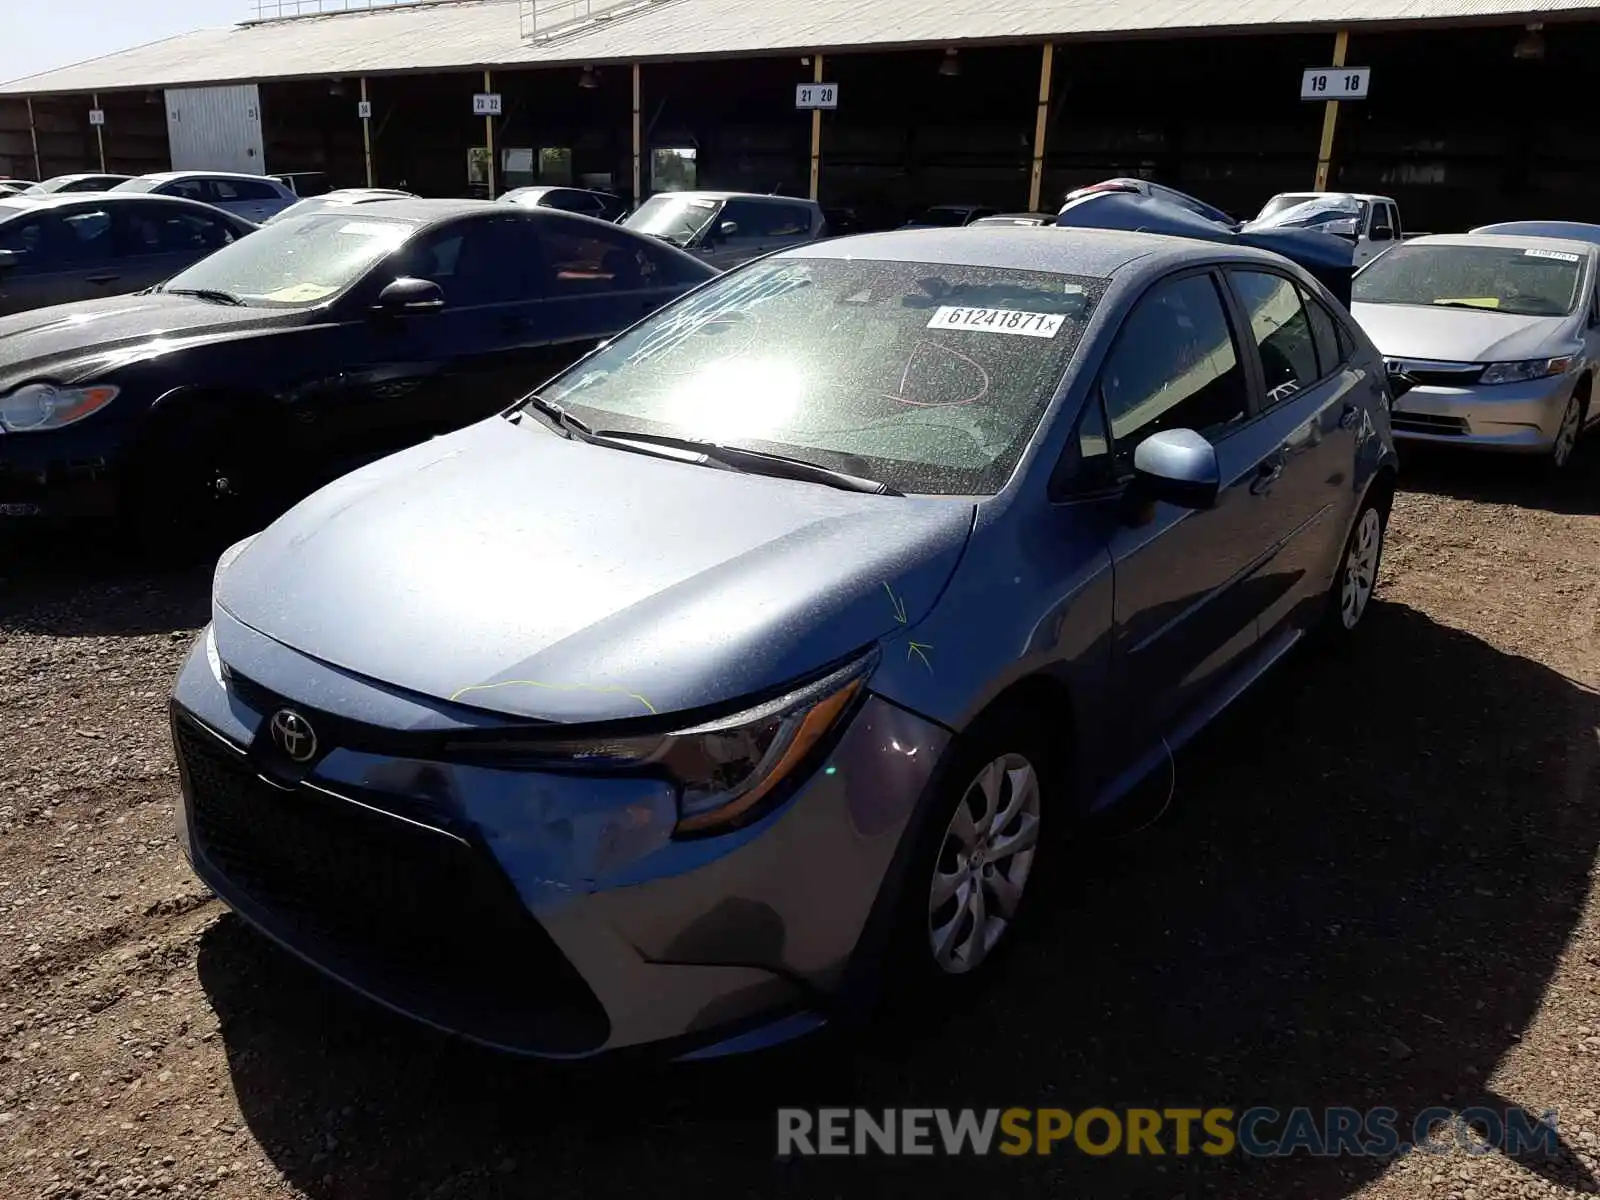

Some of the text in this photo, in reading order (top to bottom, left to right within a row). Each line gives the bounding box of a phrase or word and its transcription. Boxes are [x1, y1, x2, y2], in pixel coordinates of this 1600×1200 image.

[1311, 74, 1360, 91] 19 18
[801, 88, 833, 102] 21 20
